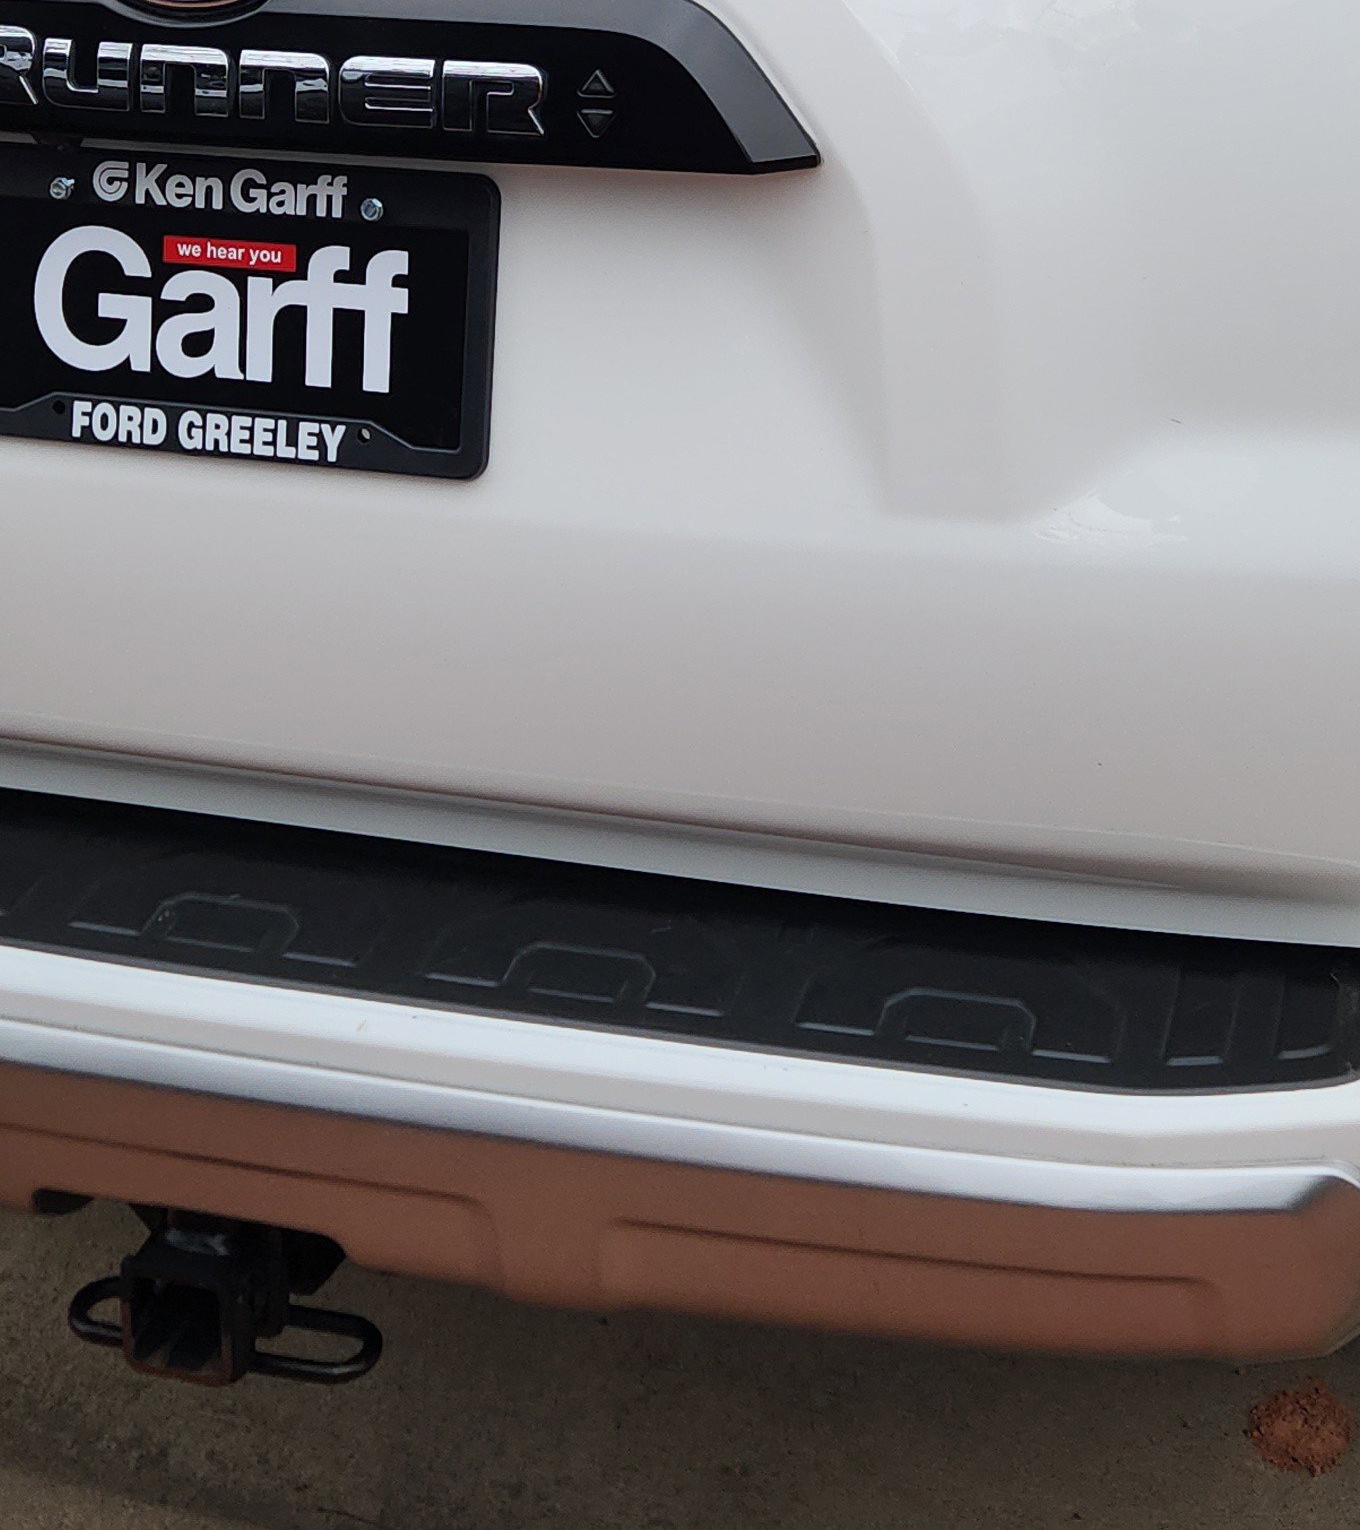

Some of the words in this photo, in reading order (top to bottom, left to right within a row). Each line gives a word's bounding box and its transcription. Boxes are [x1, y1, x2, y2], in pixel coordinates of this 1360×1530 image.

[134, 162, 223, 210] Ken
[230, 168, 348, 218] Garff
[177, 243, 201, 257] we
[206, 241, 245, 260] hear
[249, 248, 282, 266] you
[34, 225, 409, 393] Garff
[71, 400, 167, 446] FORD
[177, 410, 346, 463] GREELEY
